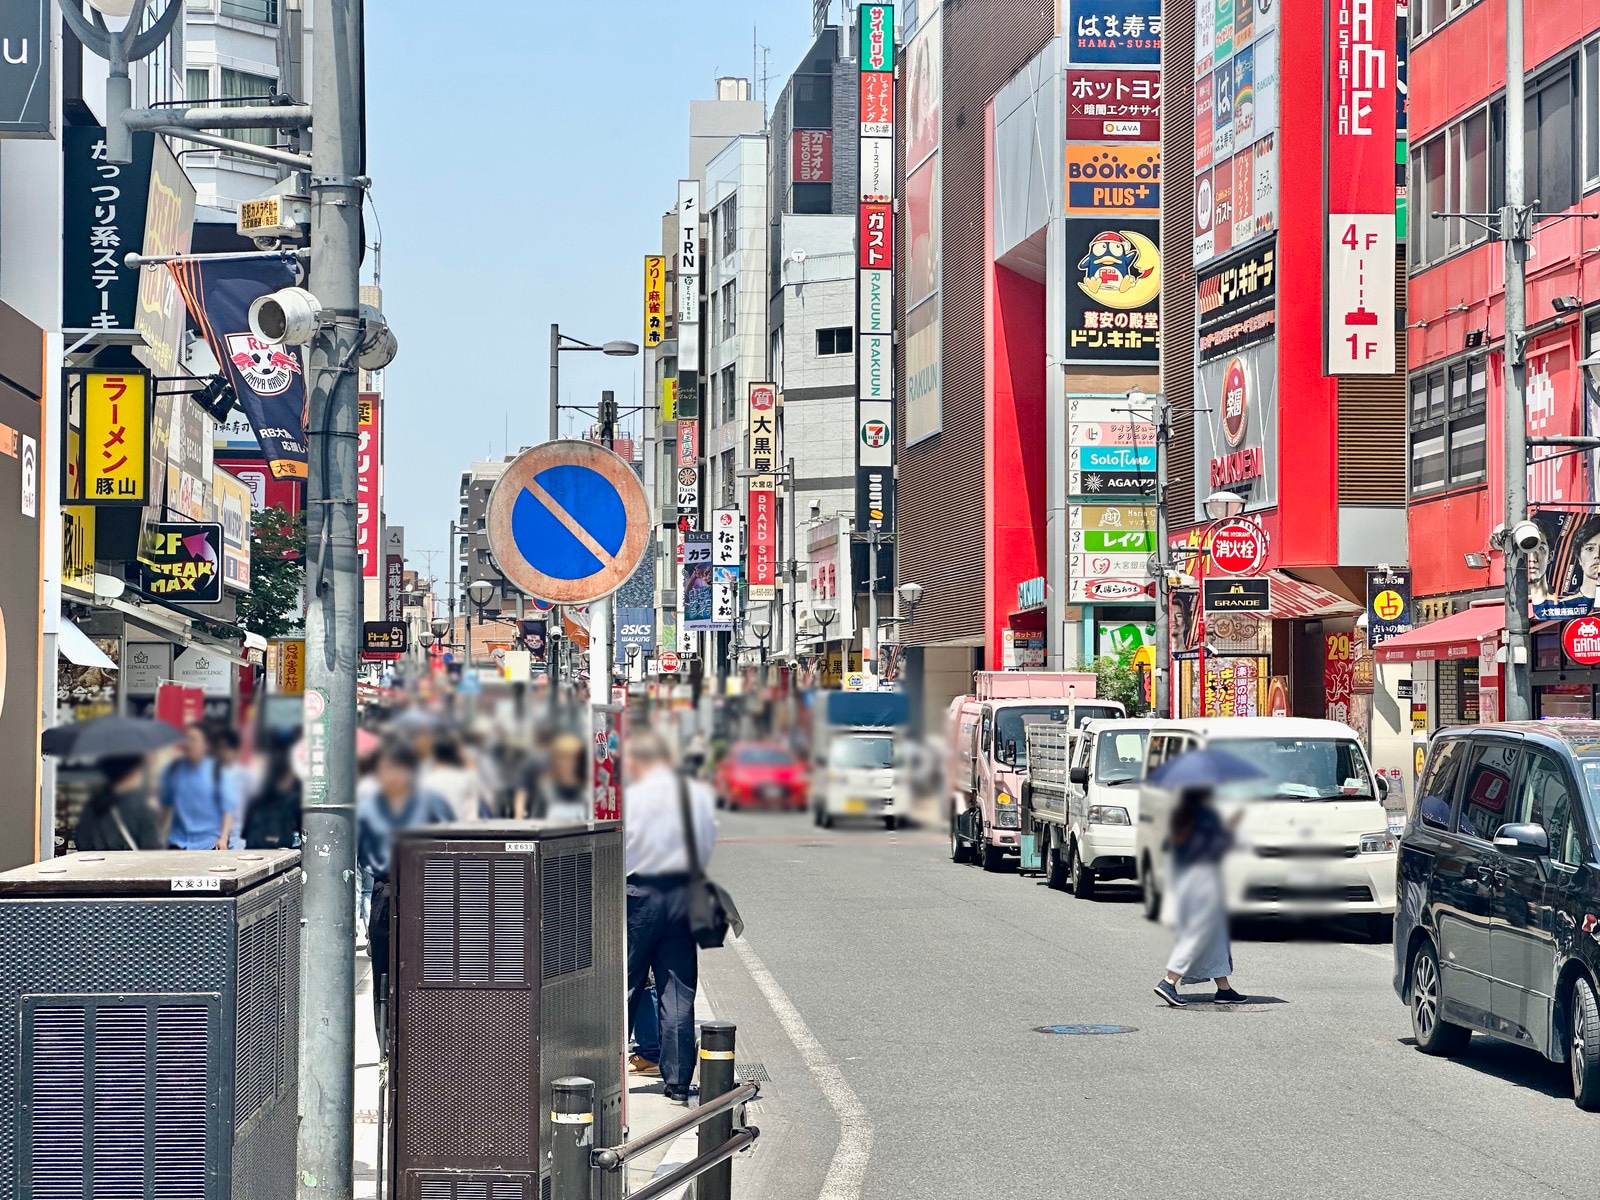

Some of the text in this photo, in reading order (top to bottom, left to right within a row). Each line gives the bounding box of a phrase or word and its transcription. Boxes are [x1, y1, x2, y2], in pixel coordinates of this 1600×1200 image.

[870, 8, 884, 69] サイゼリヤ
[866, 73, 876, 122] バイキング
[878, 73, 888, 122] しゃぶしゃぶ
[1116, 123, 1138, 131] LAVA
[800, 132, 811, 180] JOYSOUND
[811, 132, 824, 180] カラオケ
[683, 227, 694, 268] TRN
[868, 213, 884, 265] ガスト
[1342, 224, 1378, 250] 4F
[871, 273, 880, 330] RAKUUN
[1084, 311, 1158, 329] 驚安の殿堂
[1346, 333, 1377, 359] 1F
[871, 338, 880, 397] RAKUUN
[908, 363, 938, 403] RAKUUN
[755, 391, 771, 406] 質
[102, 377, 128, 474] ラーメン
[753, 416, 772, 472] 大黒屋
[1210, 446, 1263, 488] RAKUEN
[96, 477, 136, 495] 豚山
[751, 480, 773, 488] 大宮店
[757, 495, 767, 540] BRAND
[1558, 515, 1564, 526] 5
[717, 531, 735, 561] 松のや
[1103, 533, 1145, 547] レイク
[1215, 540, 1255, 559] 消火栓
[689, 548, 711, 560] カラ
[757, 546, 767, 581] SHOP
[151, 561, 214, 578] STEAK
[1571, 574, 1577, 585] 6
[151, 577, 196, 593] MAX
[1214, 599, 1260, 607] GRANDE
[1380, 592, 1398, 617] 占
[620, 624, 651, 635] asics
[1328, 635, 1349, 660] 29
[173, 879, 218, 889] 大変313
